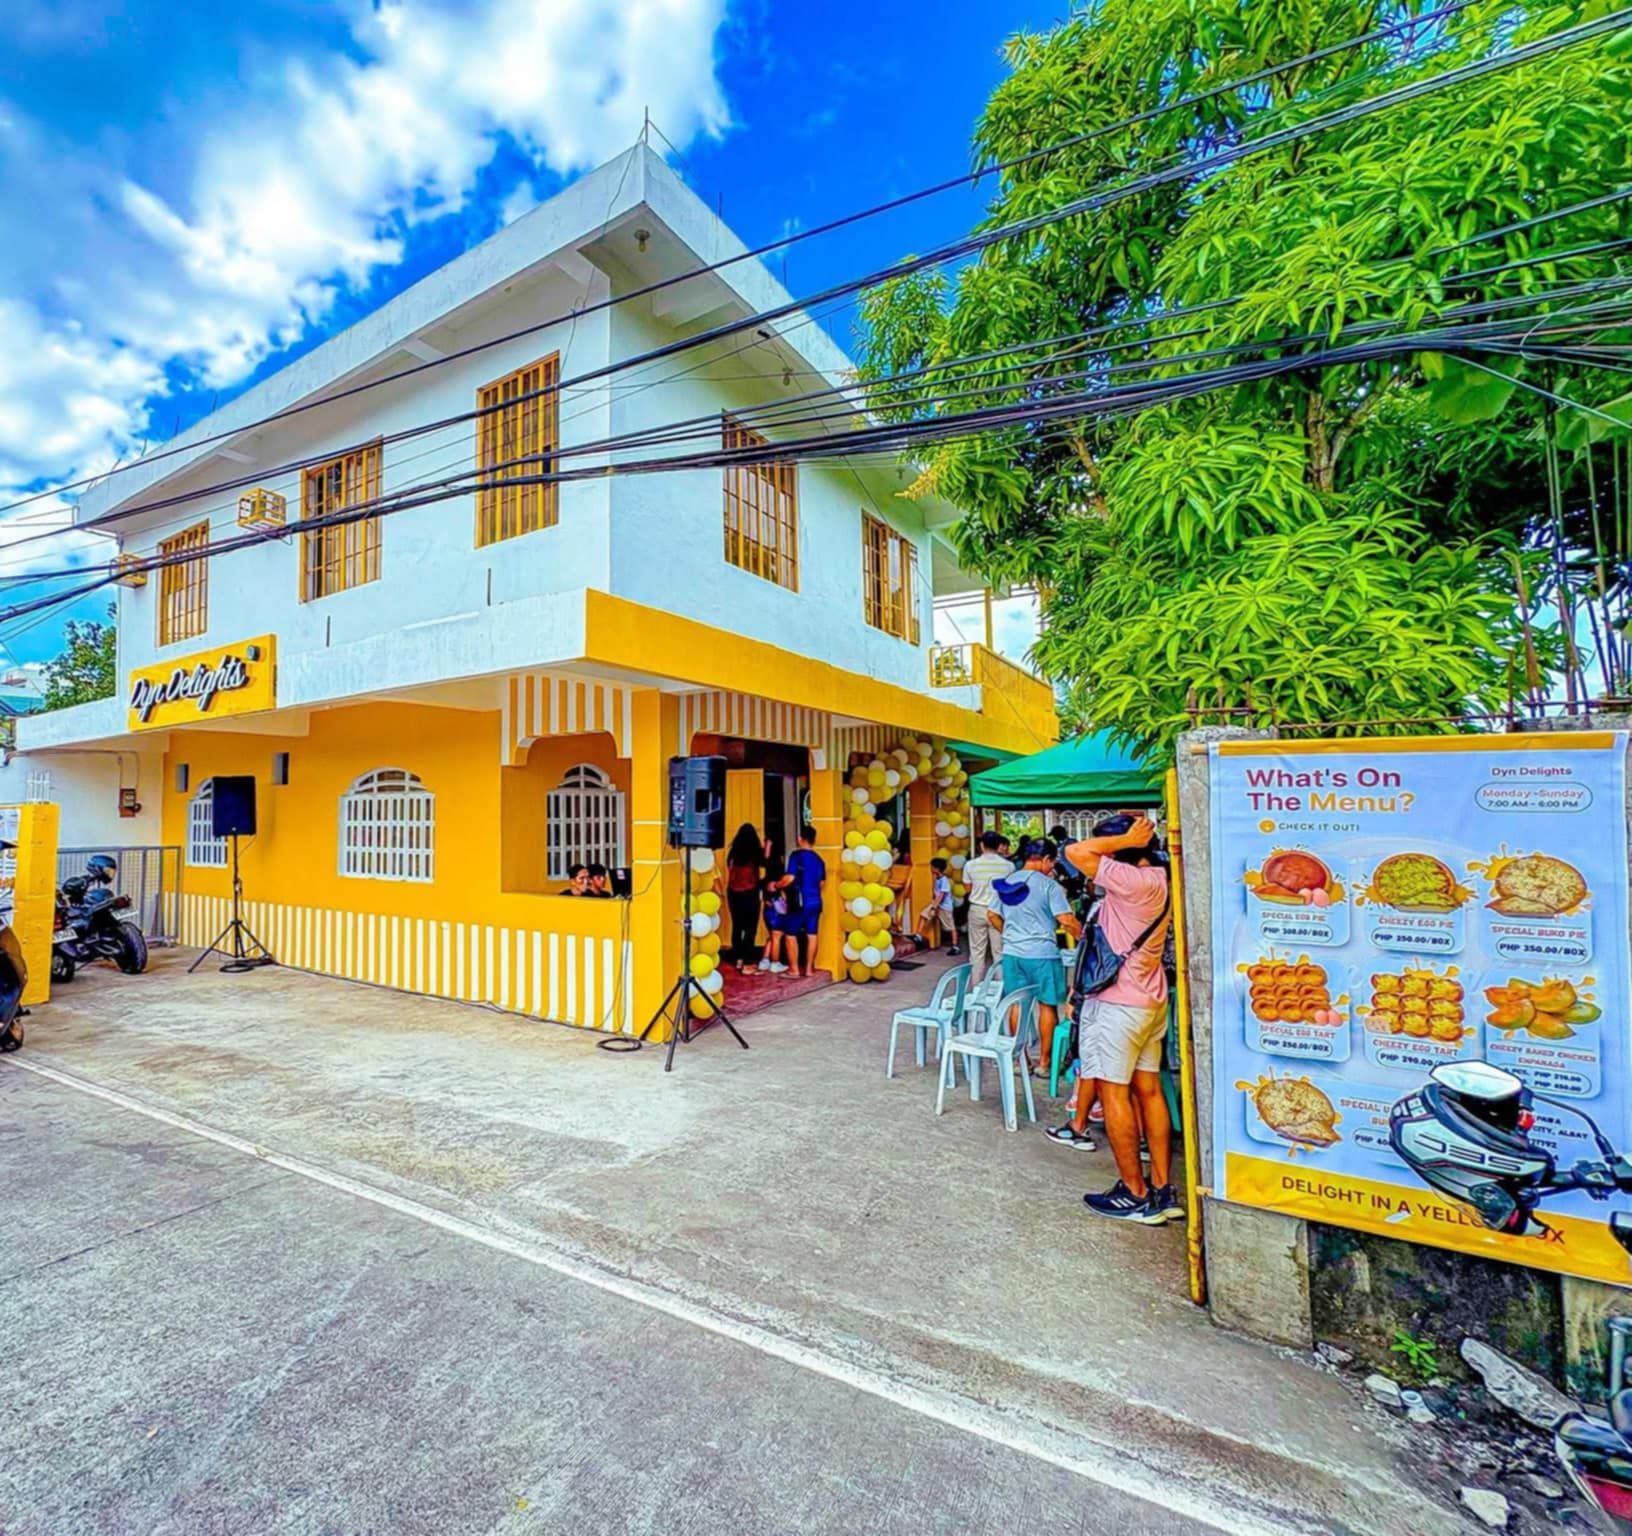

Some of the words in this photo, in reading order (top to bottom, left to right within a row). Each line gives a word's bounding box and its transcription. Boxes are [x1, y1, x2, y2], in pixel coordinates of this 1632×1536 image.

[130, 677, 169, 722] Dyn
[165, 654, 250, 711] Delights
[1492, 767, 1517, 777] Dyn
[1519, 766, 1573, 777] Delights
[1246, 768, 1348, 788] What's
[1356, 768, 1401, 788] On
[1482, 789, 1531, 799] Monday
[1246, 792, 1301, 811] The
[1310, 792, 1415, 812] Menu?
[1488, 800, 1509, 808] 7:00
[1510, 800, 1528, 808] AM
[1562, 800, 1579, 808] PM
[1278, 822, 1314, 831] CHECK
[1318, 822, 1329, 831] IT
[1332, 822, 1360, 832] OUT!
[1262, 911, 1294, 920] SPECIAL
[1263, 926, 1280, 934] PHP
[1491, 925, 1535, 936] SPECIAL
[1568, 930, 1586, 939] PIE
[1374, 933, 1394, 941] PHP
[1499, 943, 1521, 952] PHP
[1263, 1039, 1280, 1047] PHP
[1380, 1053, 1400, 1061] PHP
[1340, 1099, 1381, 1112] SPECIAL
[1355, 1134, 1374, 1143] PHP
[1281, 1175, 1366, 1205] DELIGHT
[1371, 1194, 1392, 1210] IN
[1397, 1200, 1412, 1213] A
[1416, 1202, 1487, 1230] YELLO
